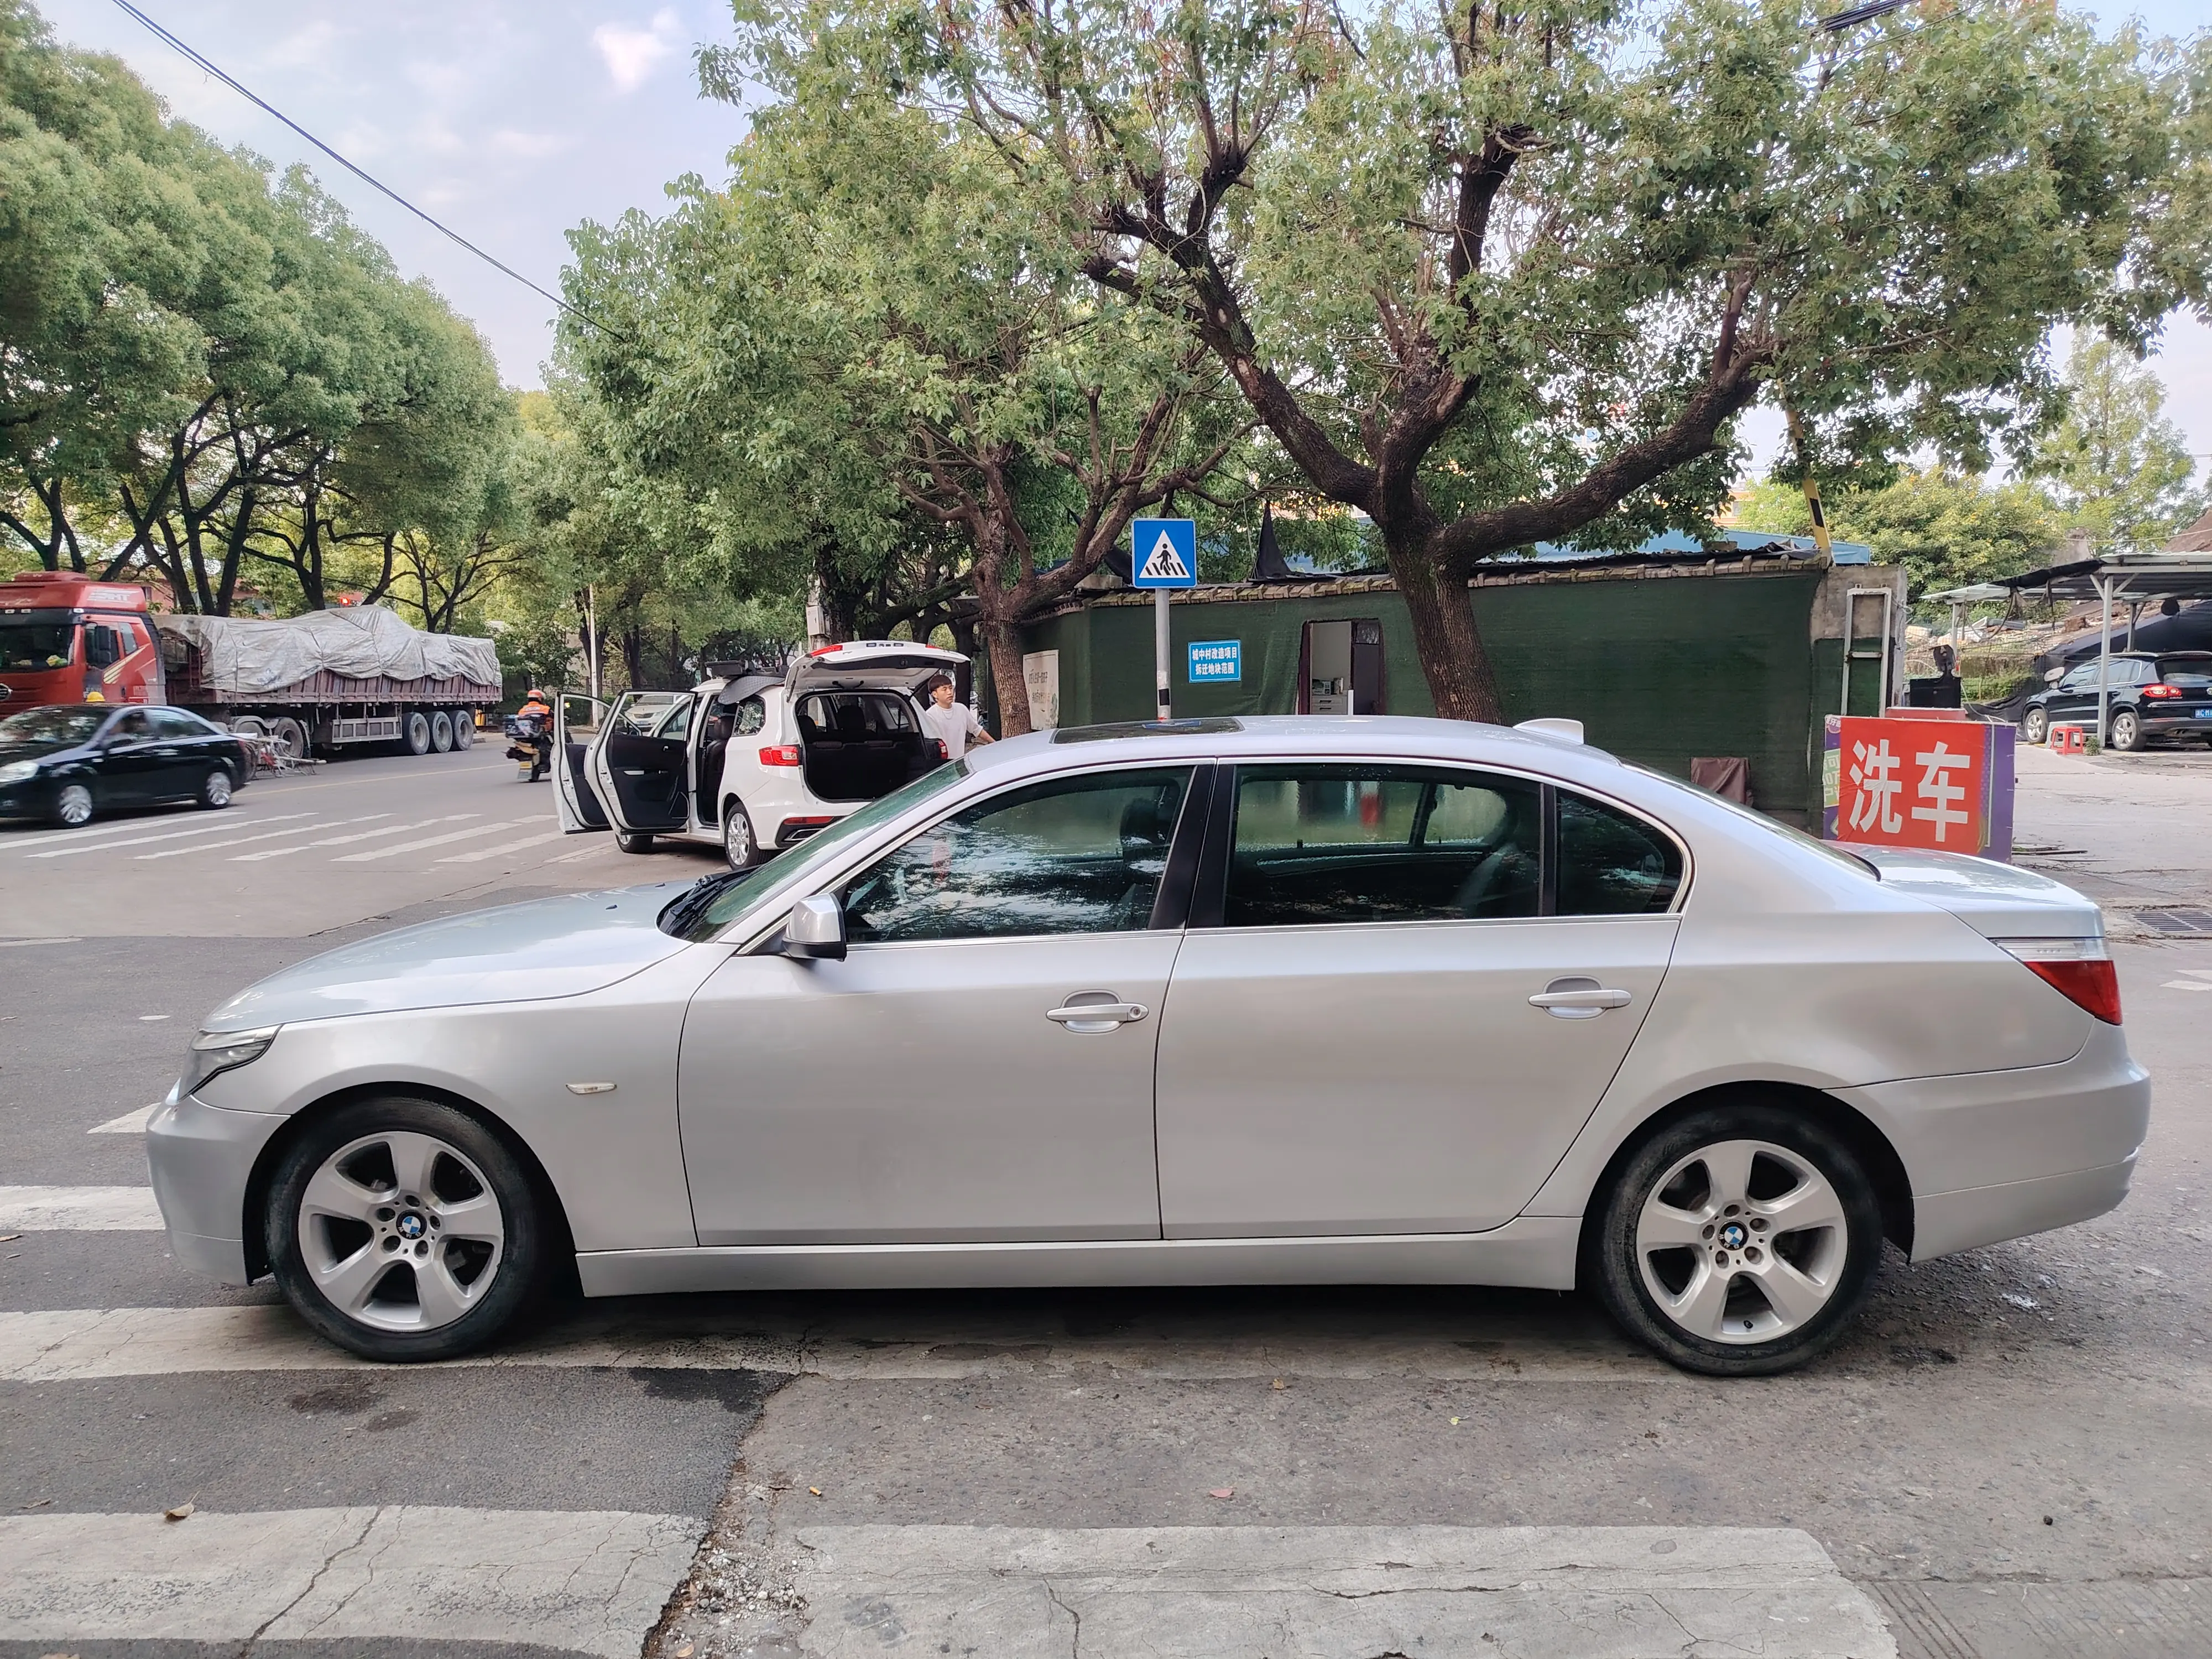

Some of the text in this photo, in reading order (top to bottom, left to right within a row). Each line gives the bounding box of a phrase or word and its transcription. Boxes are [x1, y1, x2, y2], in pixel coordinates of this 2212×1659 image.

[1192, 646, 1237, 660] 城中村改造项目
[1195, 661, 1234, 675] 拆迁地块范围
[1849, 739, 1970, 842] 洗车
[398, 1227, 422, 1239] BMW
[1718, 1234, 1740, 1249] BMW
